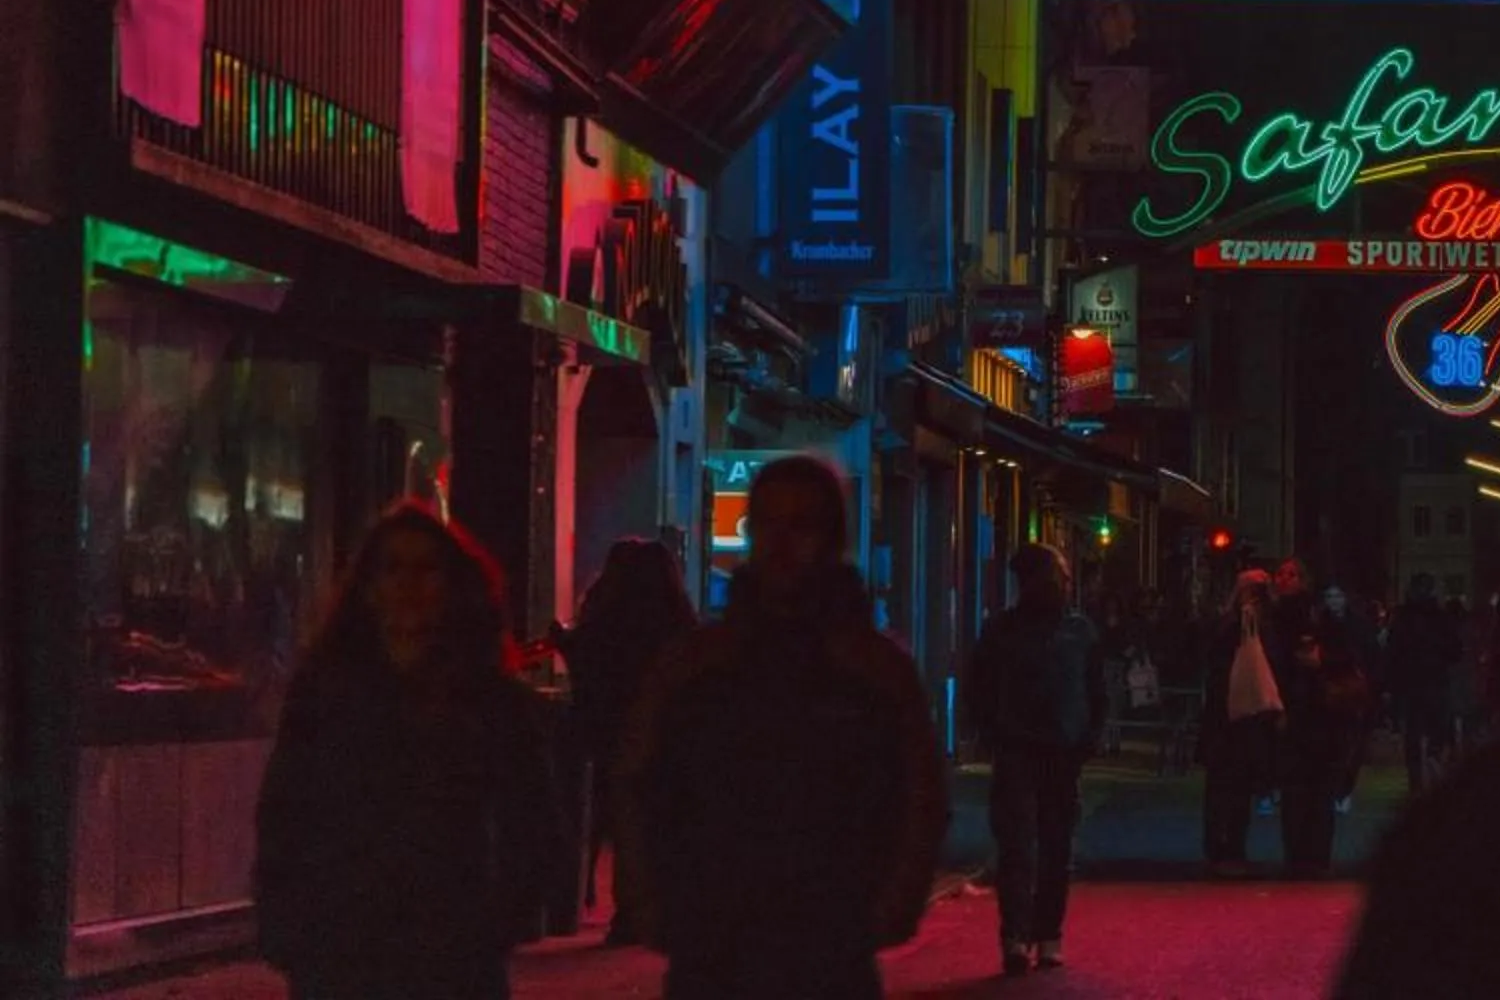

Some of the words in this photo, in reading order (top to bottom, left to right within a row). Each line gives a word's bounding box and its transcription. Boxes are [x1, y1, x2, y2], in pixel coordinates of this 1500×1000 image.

[811, 65, 860, 222] ILAY
[1217, 240, 1316, 264] tipwin
[1431, 334, 1484, 386] 36
